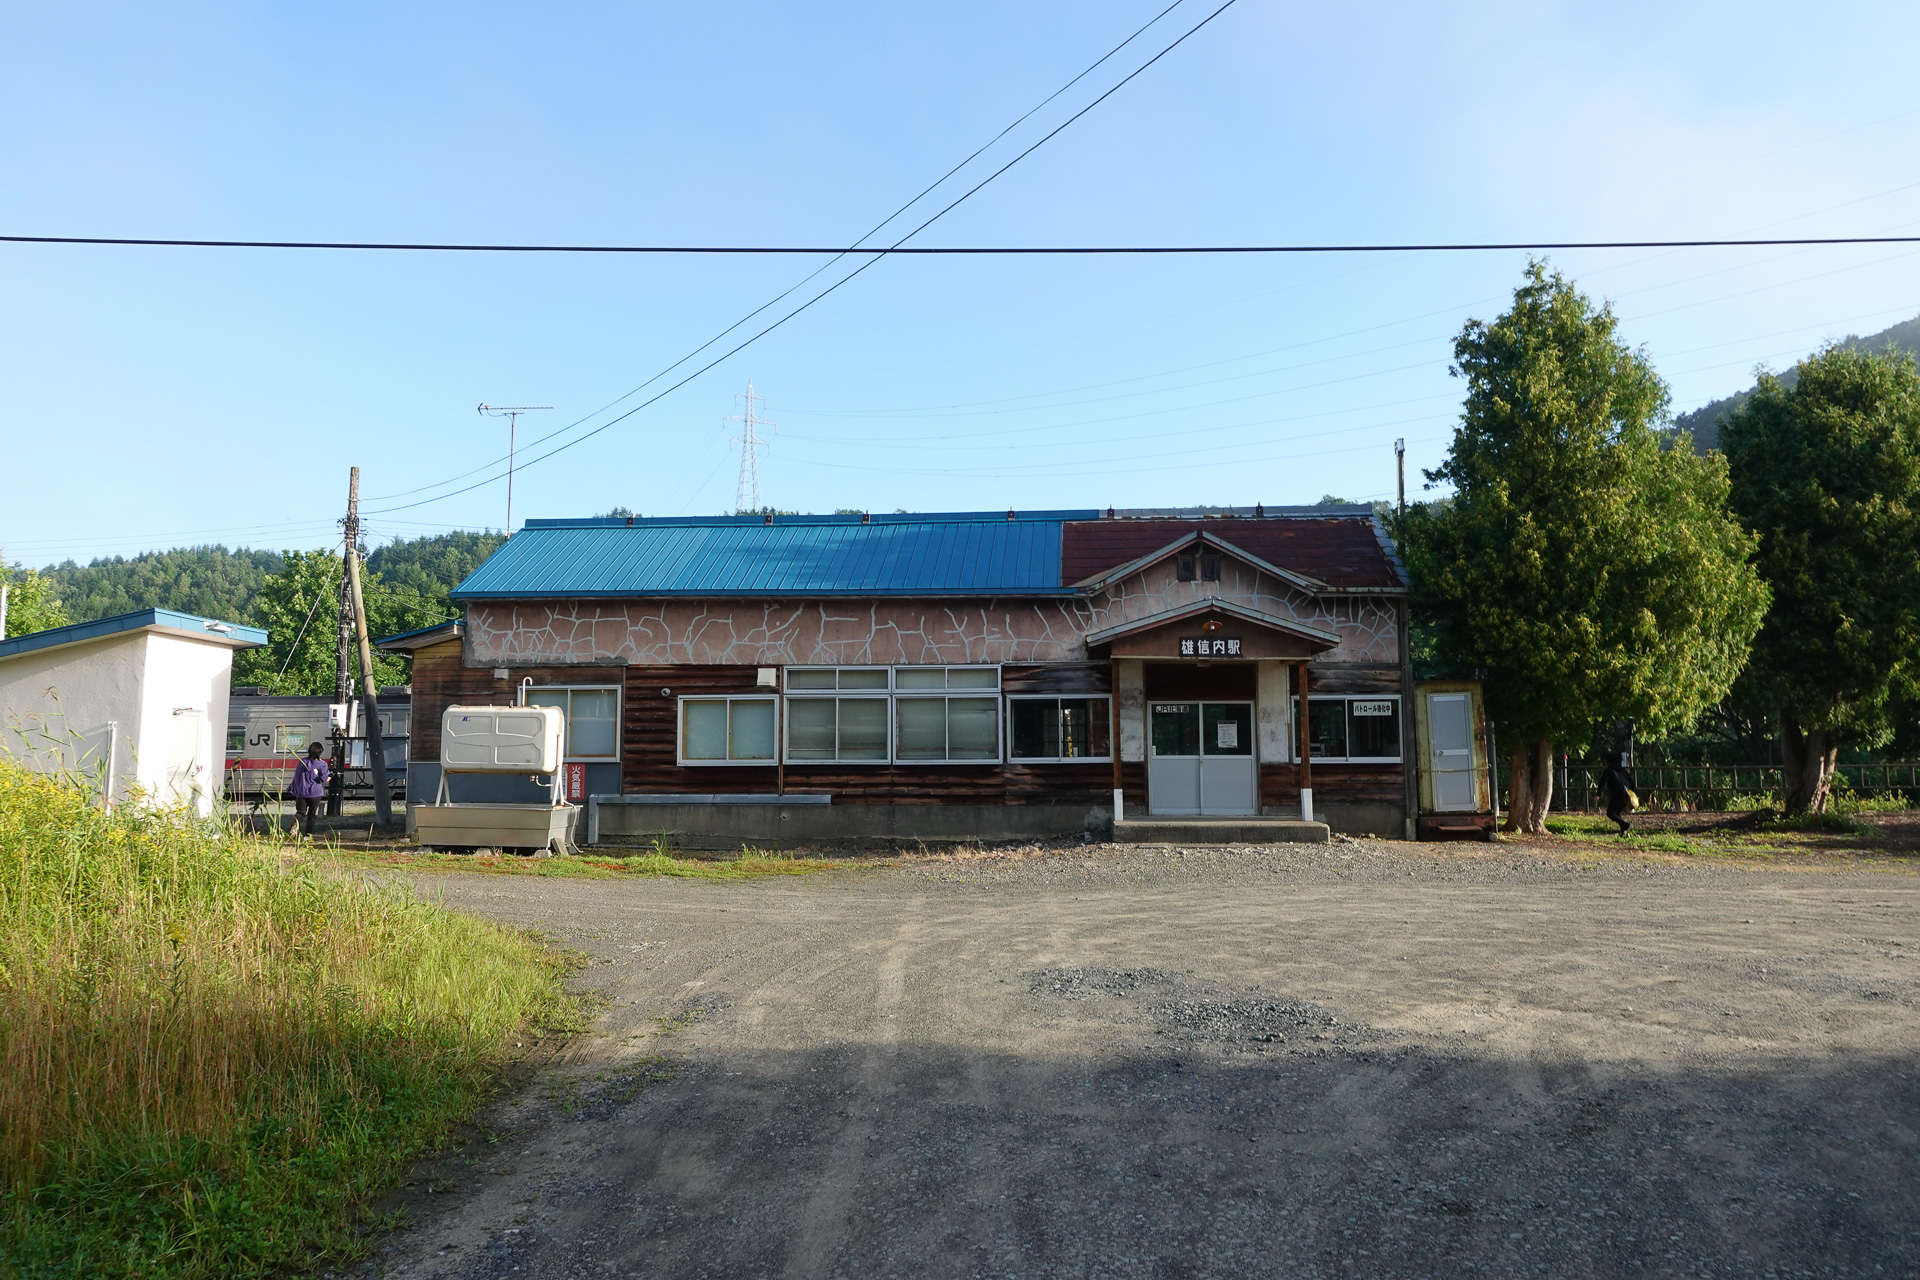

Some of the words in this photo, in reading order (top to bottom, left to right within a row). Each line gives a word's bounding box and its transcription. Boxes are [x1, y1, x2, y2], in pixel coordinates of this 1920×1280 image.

[1181, 639, 1240, 654] 雄信内駅
[249, 733, 270, 746] JR
[571, 765, 581, 798] 火気厳禁
